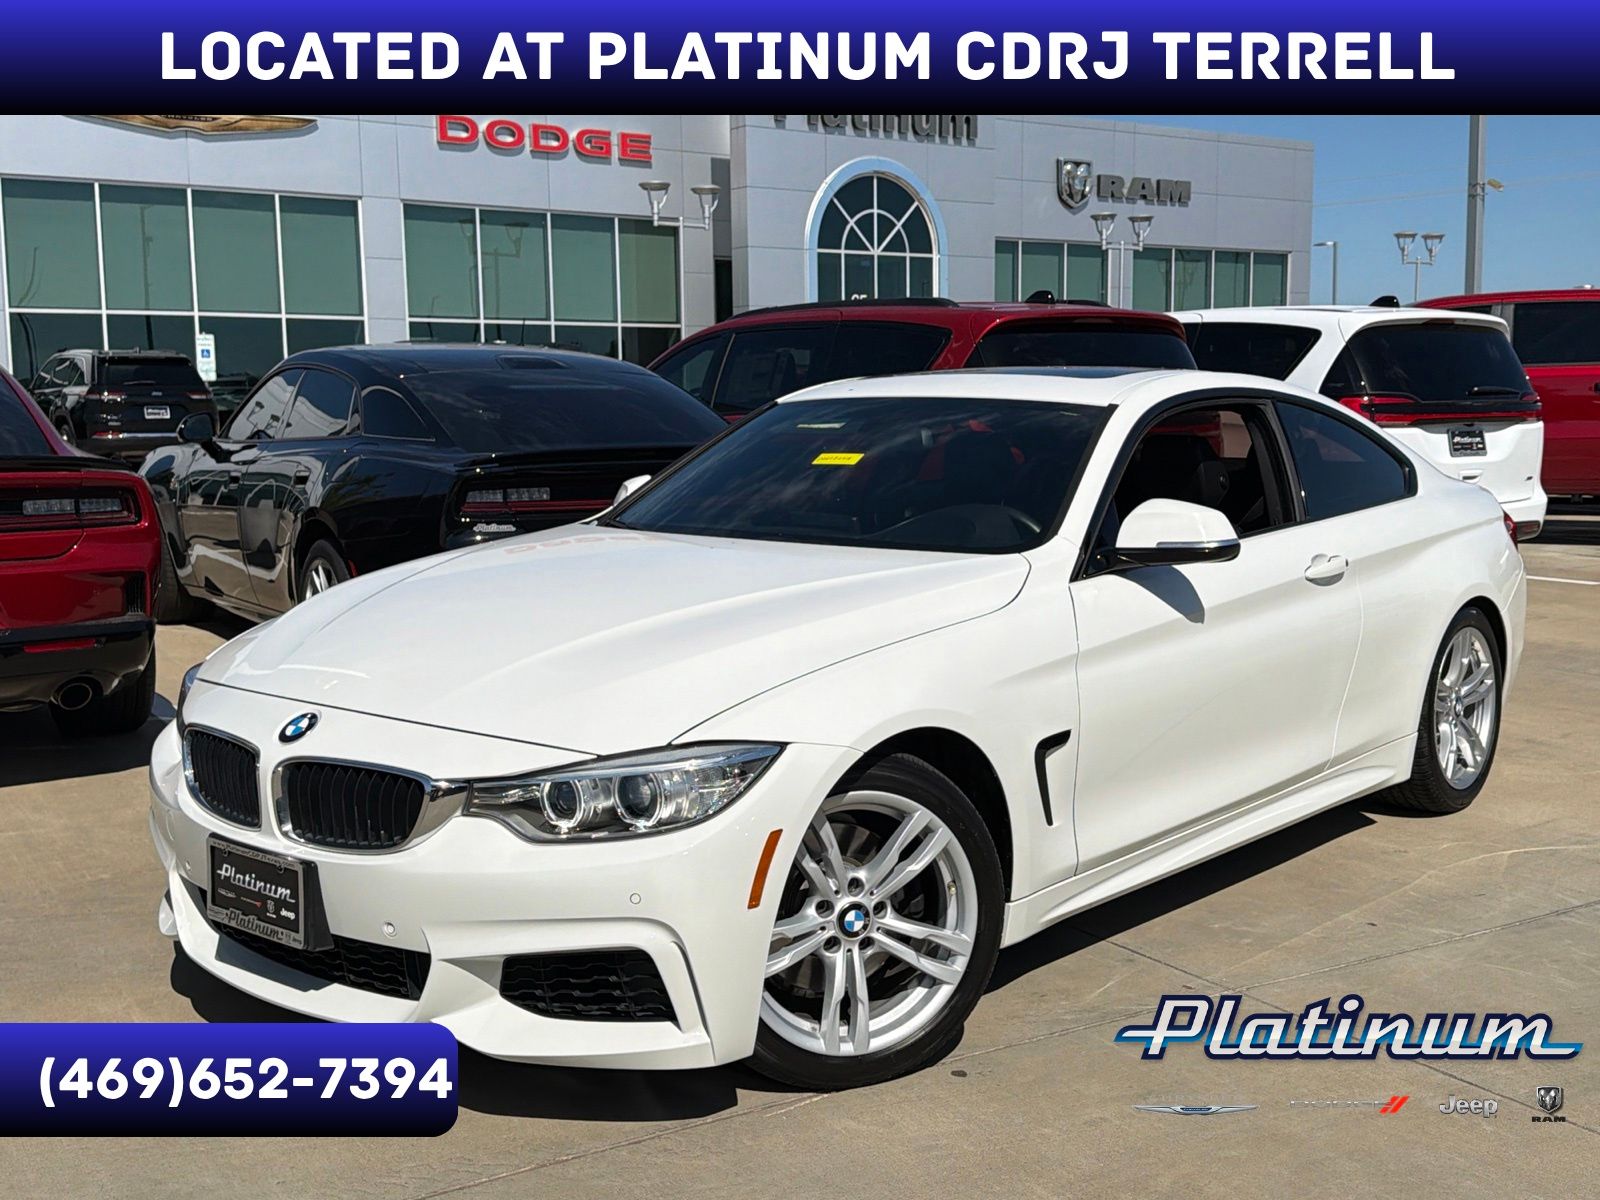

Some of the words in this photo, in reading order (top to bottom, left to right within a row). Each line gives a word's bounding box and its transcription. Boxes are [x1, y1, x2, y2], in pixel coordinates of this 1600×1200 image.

[436, 115, 652, 161] DODGE
[774, 114, 977, 140] atinum
[1097, 174, 1191, 202] RAM
[217, 863, 296, 903] Platinum
[228, 908, 283, 941] Platinum
